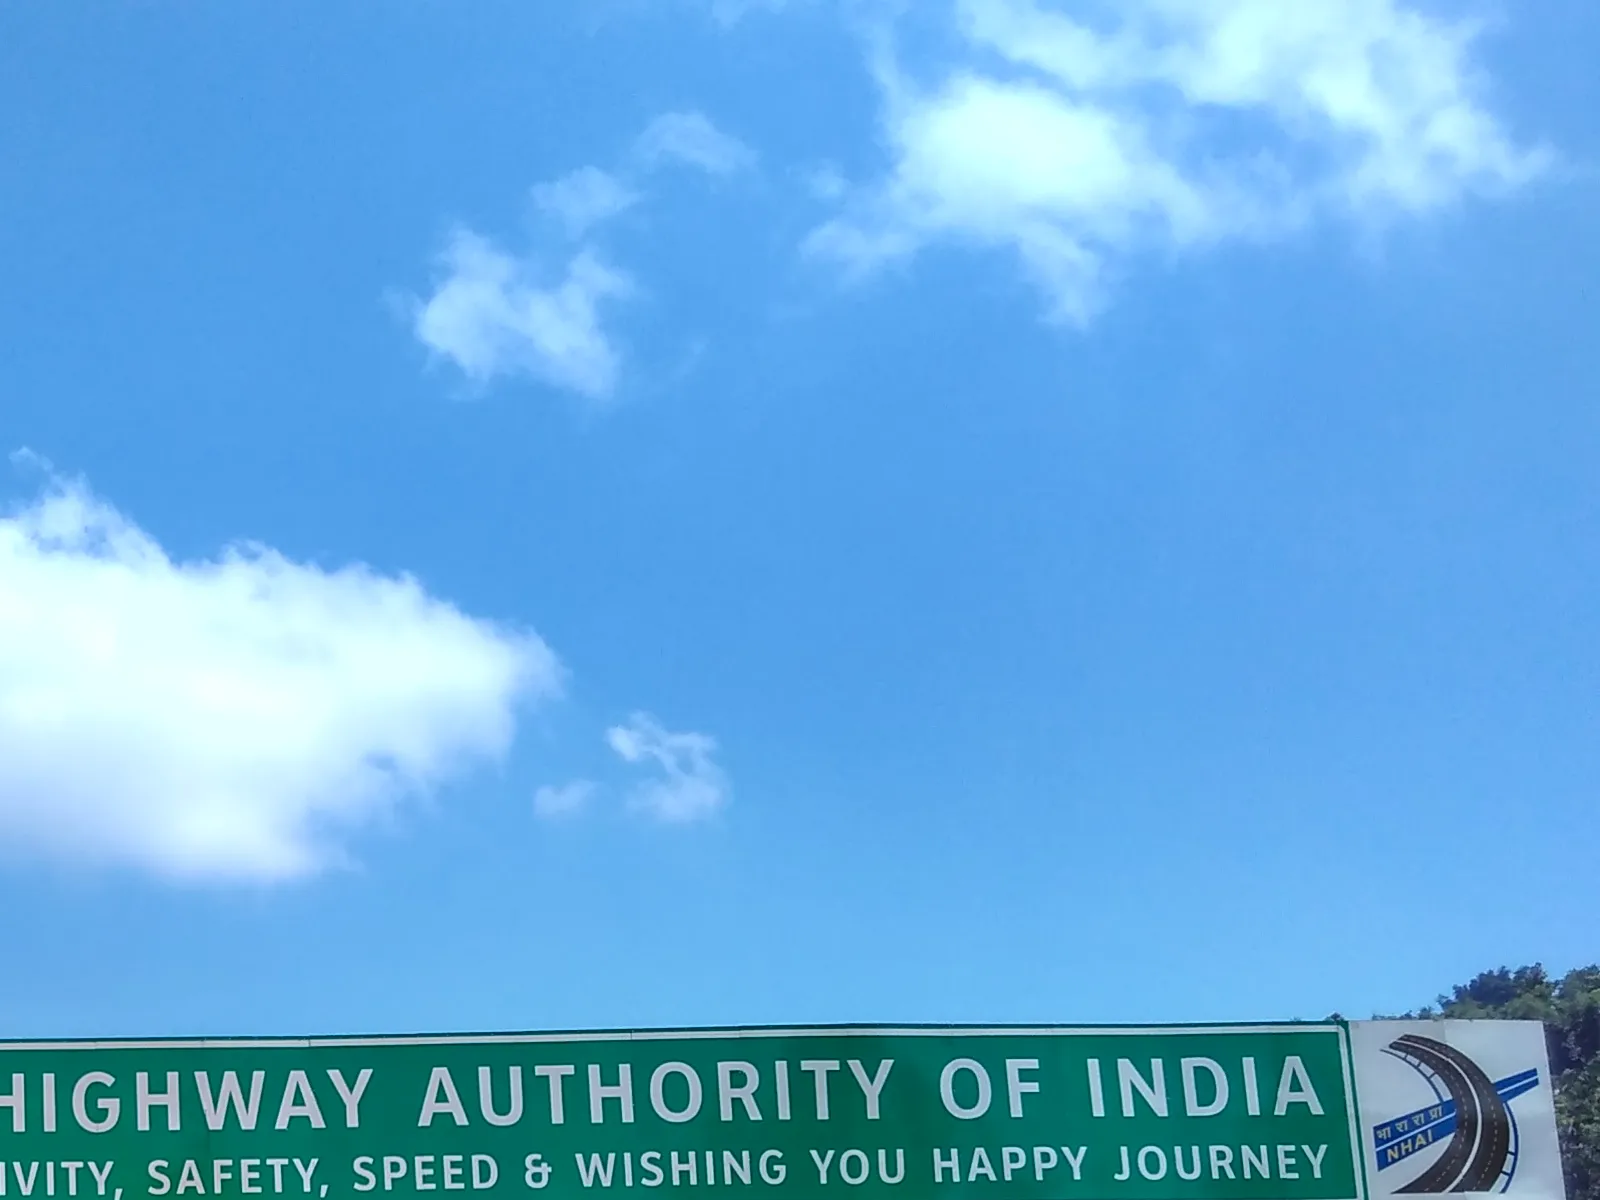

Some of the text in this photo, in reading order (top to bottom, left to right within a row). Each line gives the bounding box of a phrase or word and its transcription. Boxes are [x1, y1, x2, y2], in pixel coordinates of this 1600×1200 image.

[418, 1060, 895, 1126] AUTHORITY
[940, 1058, 1040, 1119] OF
[1087, 1055, 1325, 1117] INDIA
[147, 1158, 329, 1198] SAFETY,
[353, 1154, 499, 1191] SPEED
[525, 1153, 551, 1189] &
[575, 1150, 787, 1188] WISHING
[810, 1149, 905, 1185] YOU
[933, 1147, 1088, 1183] HAPPY
[1114, 1144, 1328, 1181] JOURNEY
[1387, 1129, 1433, 1162] NHAI
